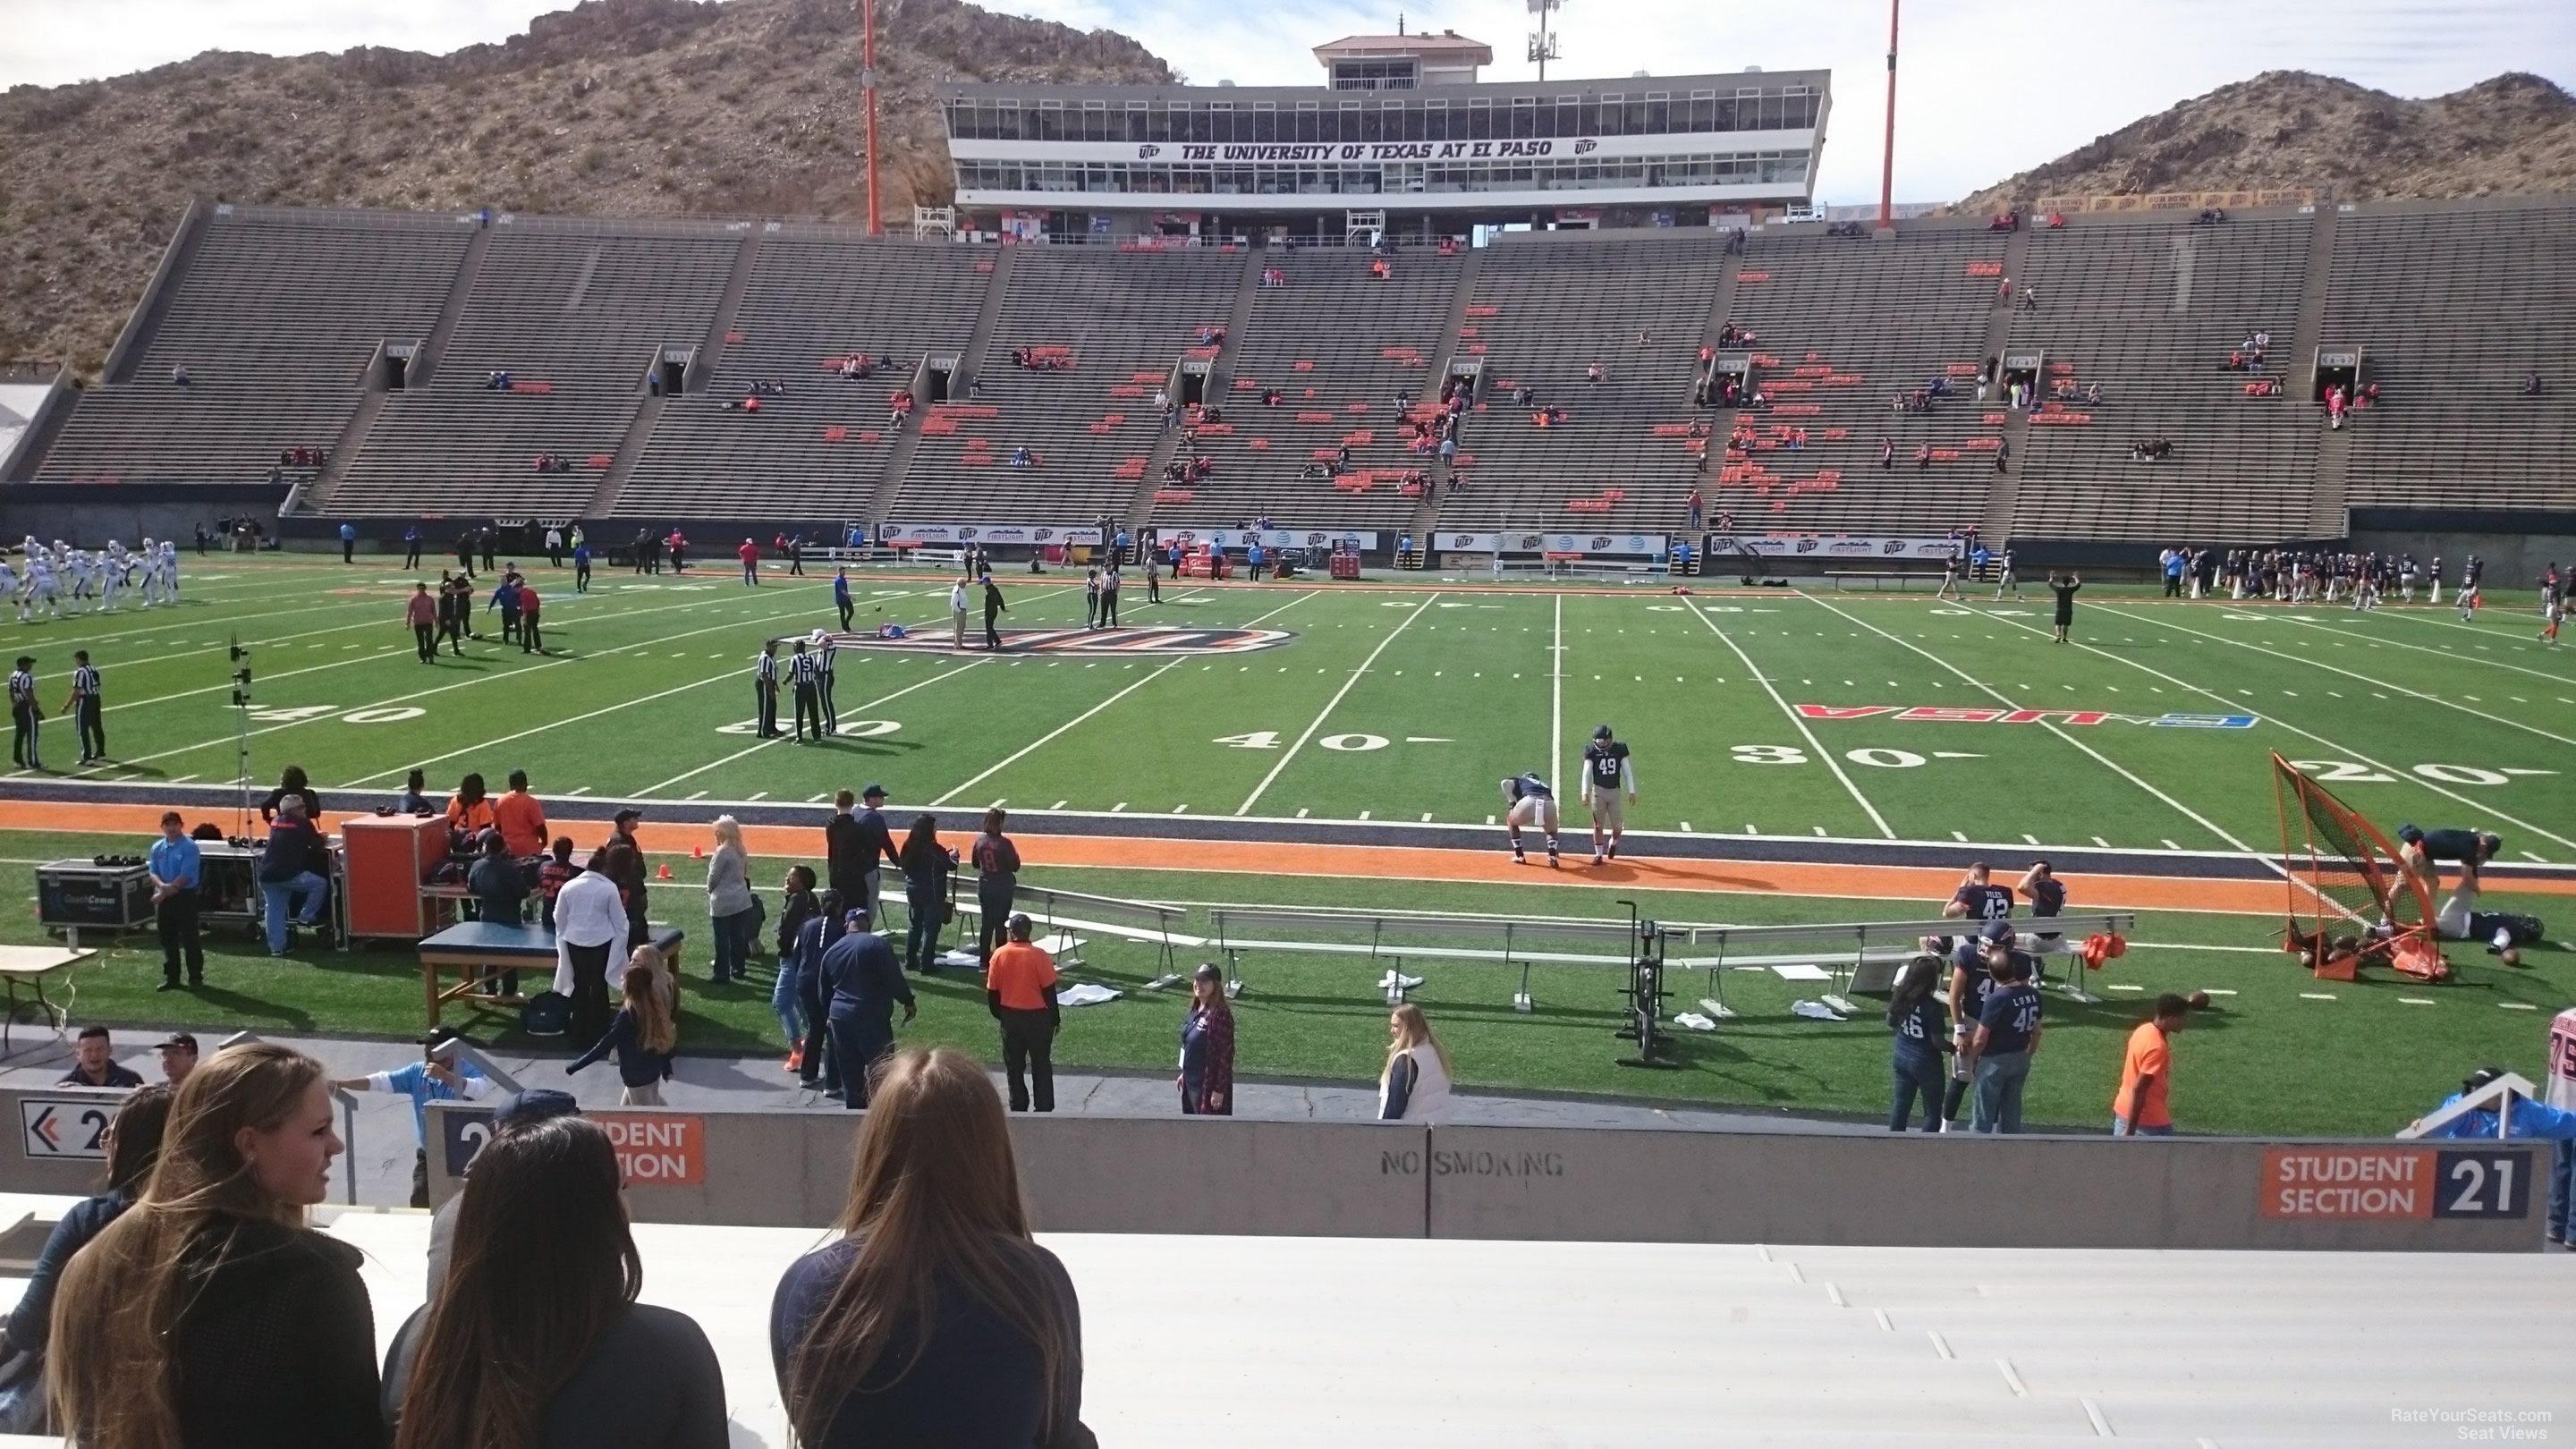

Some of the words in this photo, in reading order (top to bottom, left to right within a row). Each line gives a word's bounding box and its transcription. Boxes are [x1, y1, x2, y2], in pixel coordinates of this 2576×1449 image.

[1139, 144, 1160, 159] UTEP
[1182, 145, 1217, 159] THE
[1224, 145, 1337, 159] UNIVERSITY
[1341, 145, 1366, 159] OF
[1371, 143, 1433, 158] TEXAS
[1438, 142, 1467, 157] AT
[1470, 141, 1492, 157] EL
[1496, 140, 1553, 157] PASO
[1574, 139, 1597, 155] UTEP
[883, 526, 902, 539] UTEP
[959, 527, 978, 540] UTEP
[1035, 528, 1054, 542] UTEP
[1308, 532, 1327, 547] UTEP
[1453, 535, 1474, 548] UTEP
[1591, 536, 1613, 550] UTEP
[1798, 538, 1818, 554] UTEP
[1884, 539, 1907, 555] UTEP
[802, 658, 810, 671] S
[1598, 758, 1616, 775] 49
[2012, 1005, 2039, 1033] 46
[604, 1122, 687, 1148] DENT
[617, 1153, 686, 1179] TION
[1381, 1150, 1419, 1175] NO
[1434, 1150, 1563, 1177] SMOKING
[2279, 1156, 2419, 1182] STUDENT
[2448, 1158, 2514, 1212] 21
[2280, 1188, 2415, 1214] SECTION
